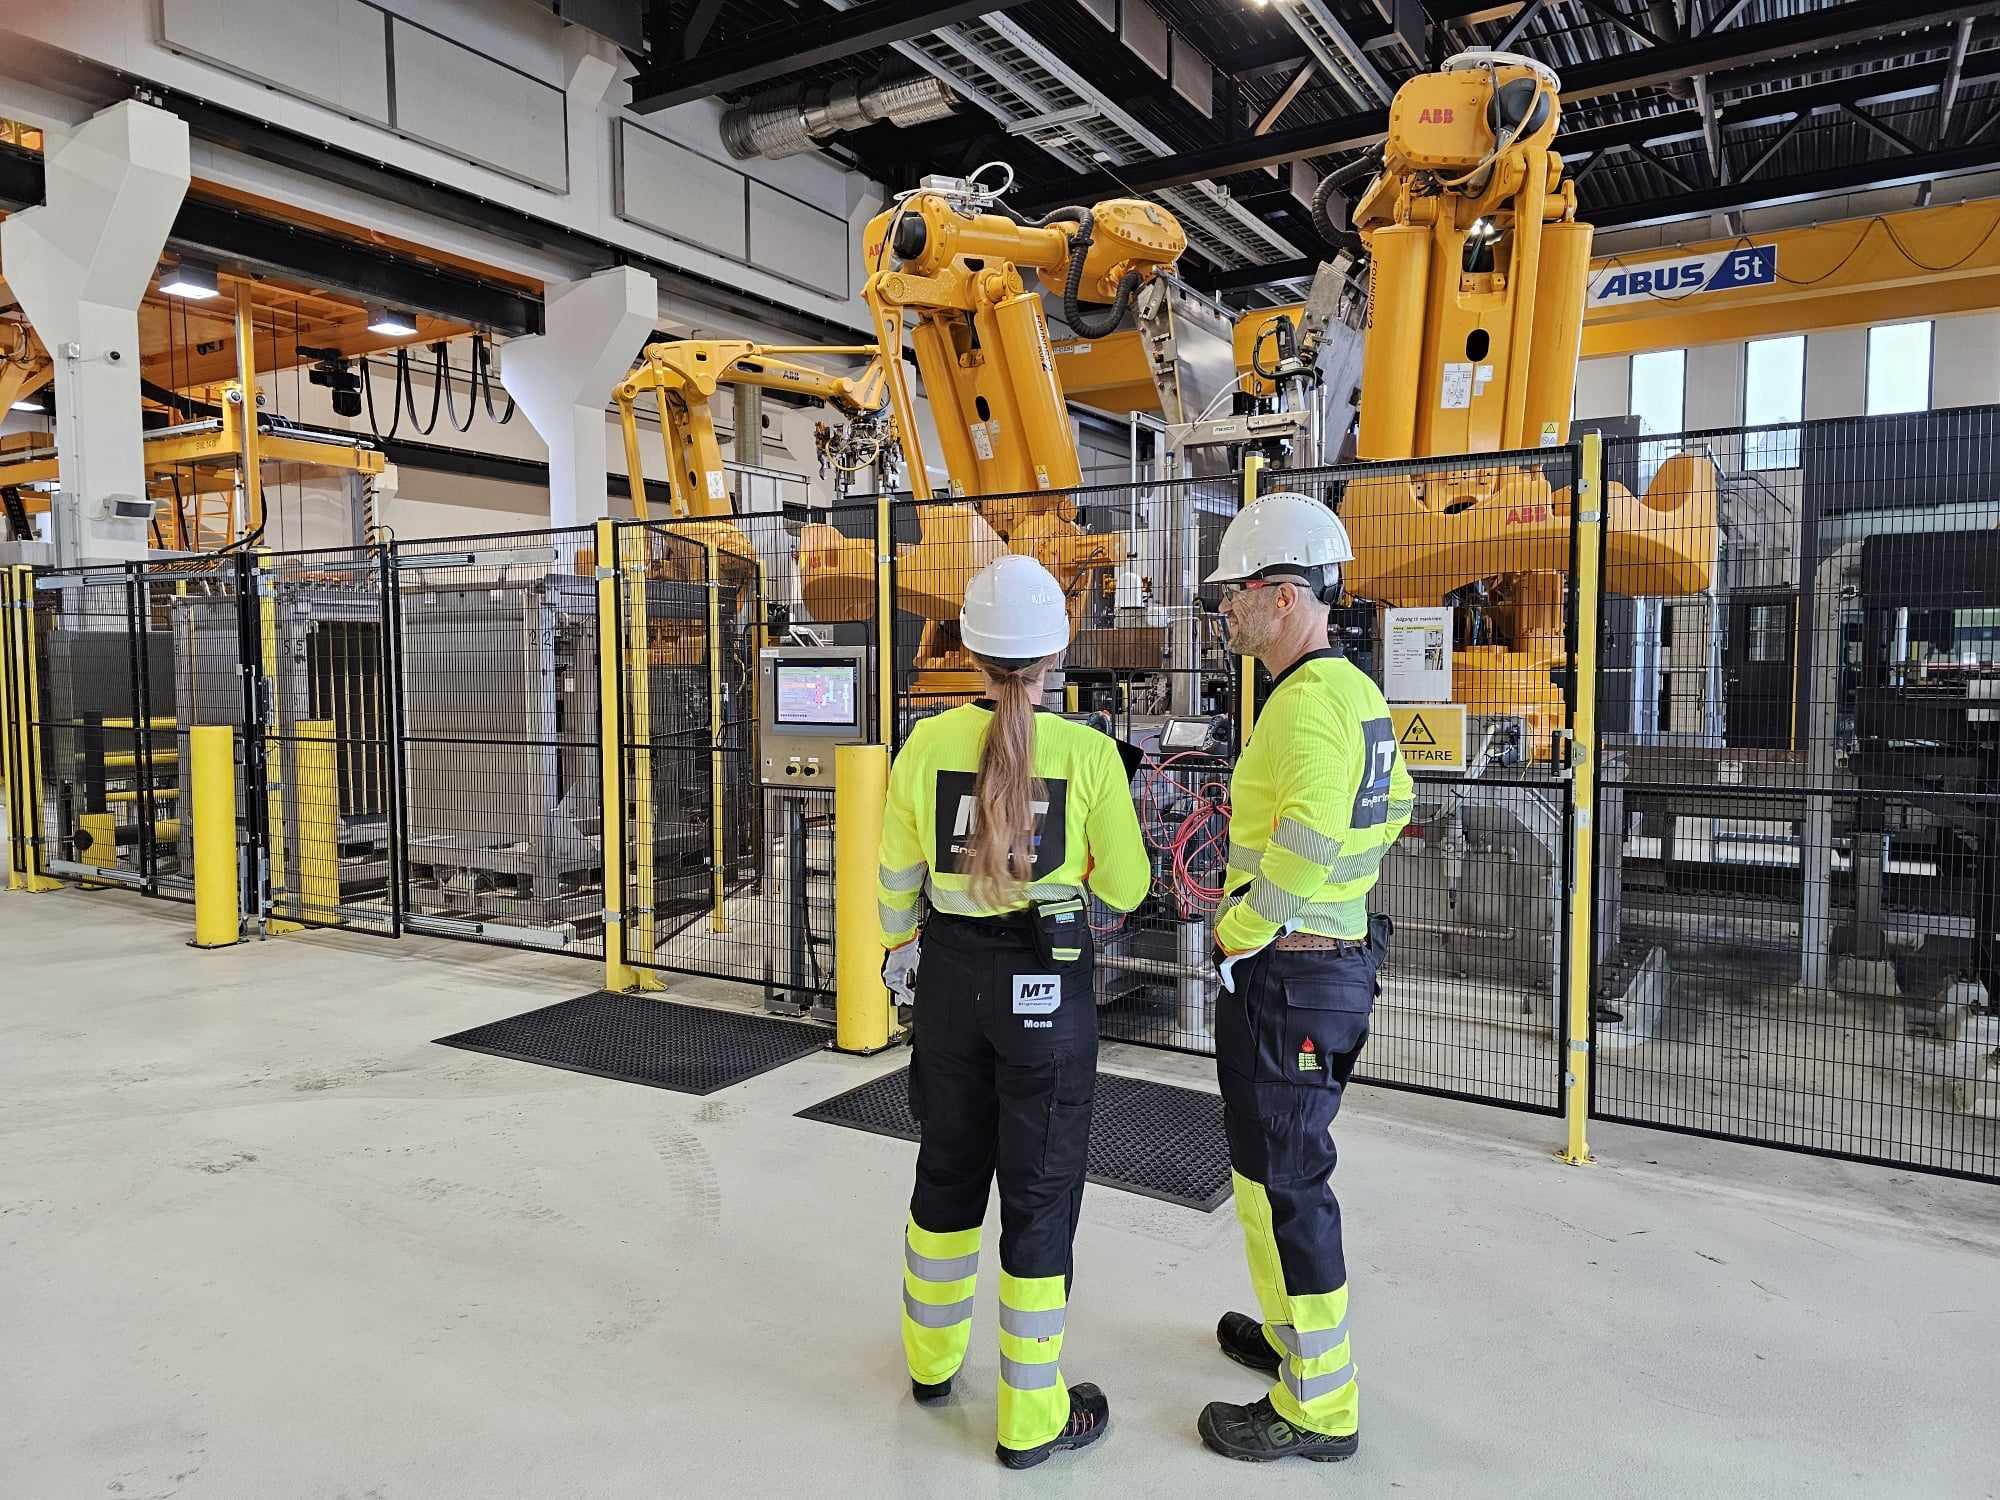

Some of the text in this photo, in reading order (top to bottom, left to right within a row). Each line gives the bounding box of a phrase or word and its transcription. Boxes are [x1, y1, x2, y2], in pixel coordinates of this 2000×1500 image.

[1418, 108, 1454, 124] ABB
[1597, 254, 1763, 300] ABUS 5t
[783, 370, 800, 381] ABB
[1506, 506, 1546, 525] ABB
[1401, 750, 1453, 761] TTFARE
[1020, 983, 1056, 999] MT
[1023, 1019, 1053, 1028] Mona
